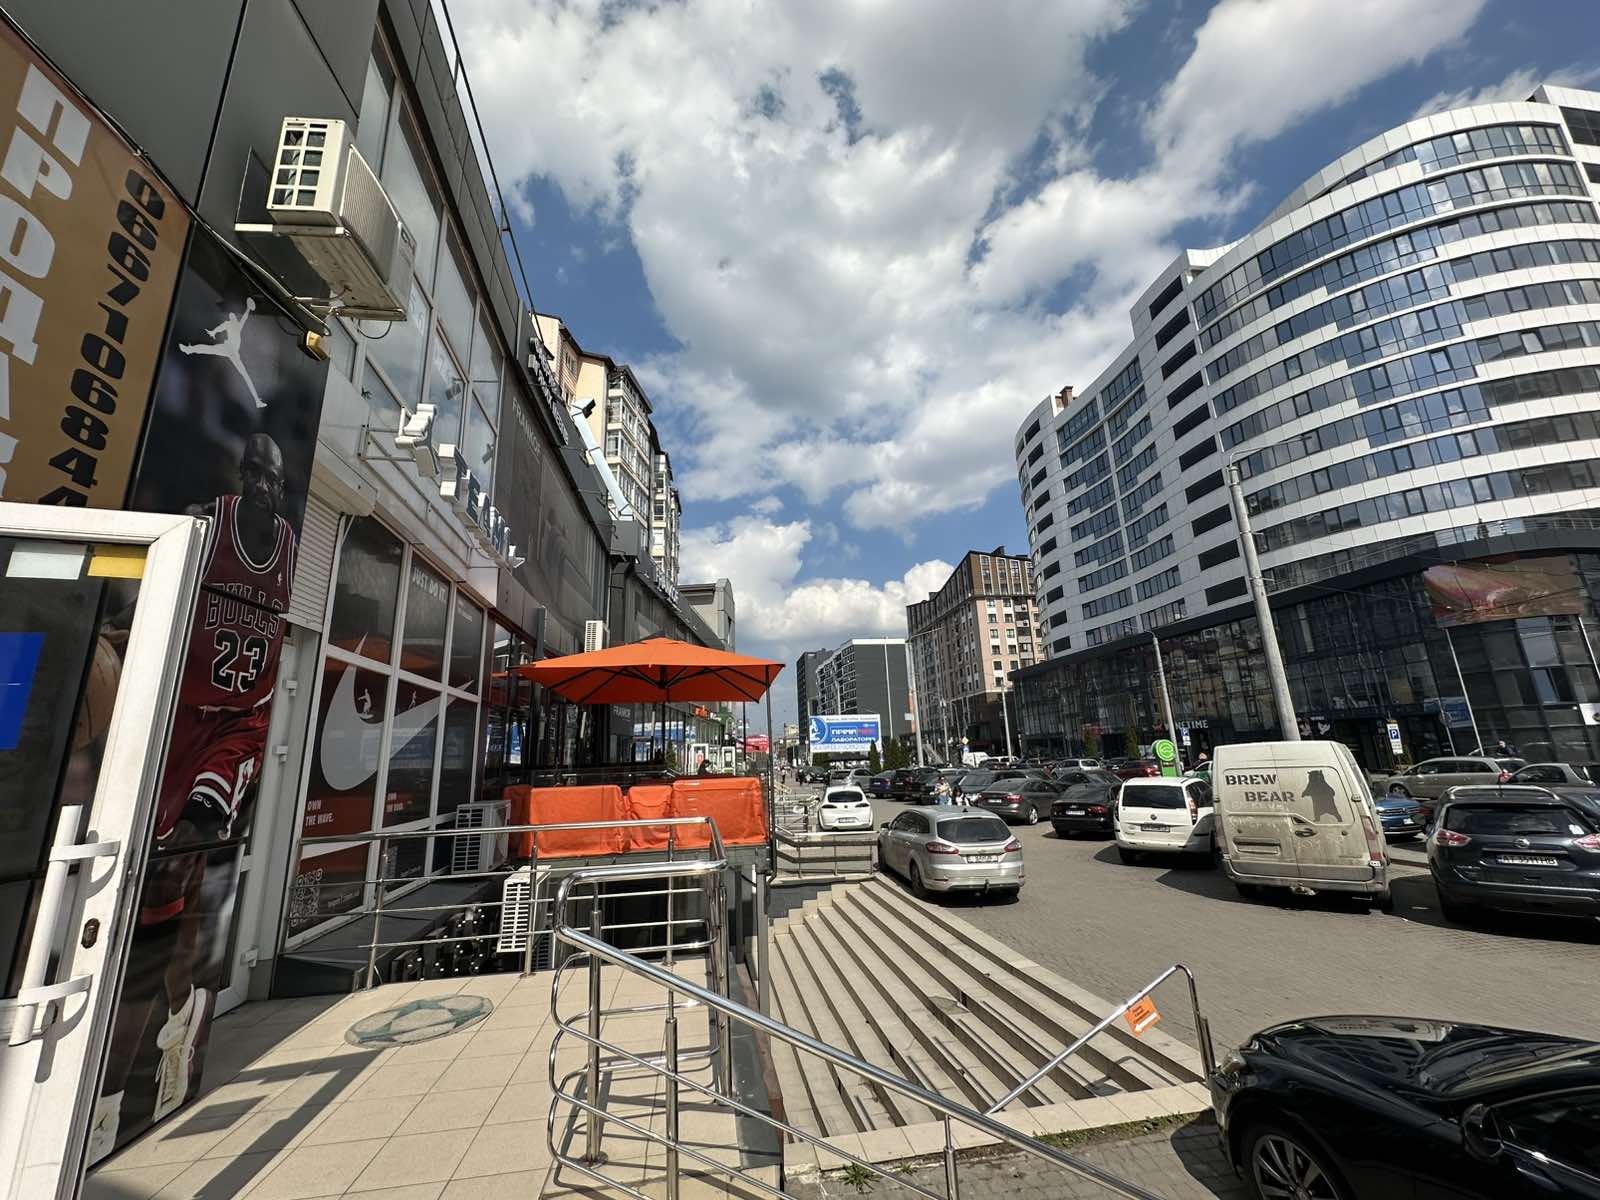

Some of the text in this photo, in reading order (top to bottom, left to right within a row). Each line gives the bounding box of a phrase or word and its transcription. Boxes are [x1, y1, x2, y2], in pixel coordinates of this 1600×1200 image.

[204, 583, 282, 640] BULLS
[211, 628, 269, 693] 23
[1163, 719, 1209, 730] WNETIME
[1225, 774, 1277, 785] BREW
[1244, 791, 1295, 802] BEAR
